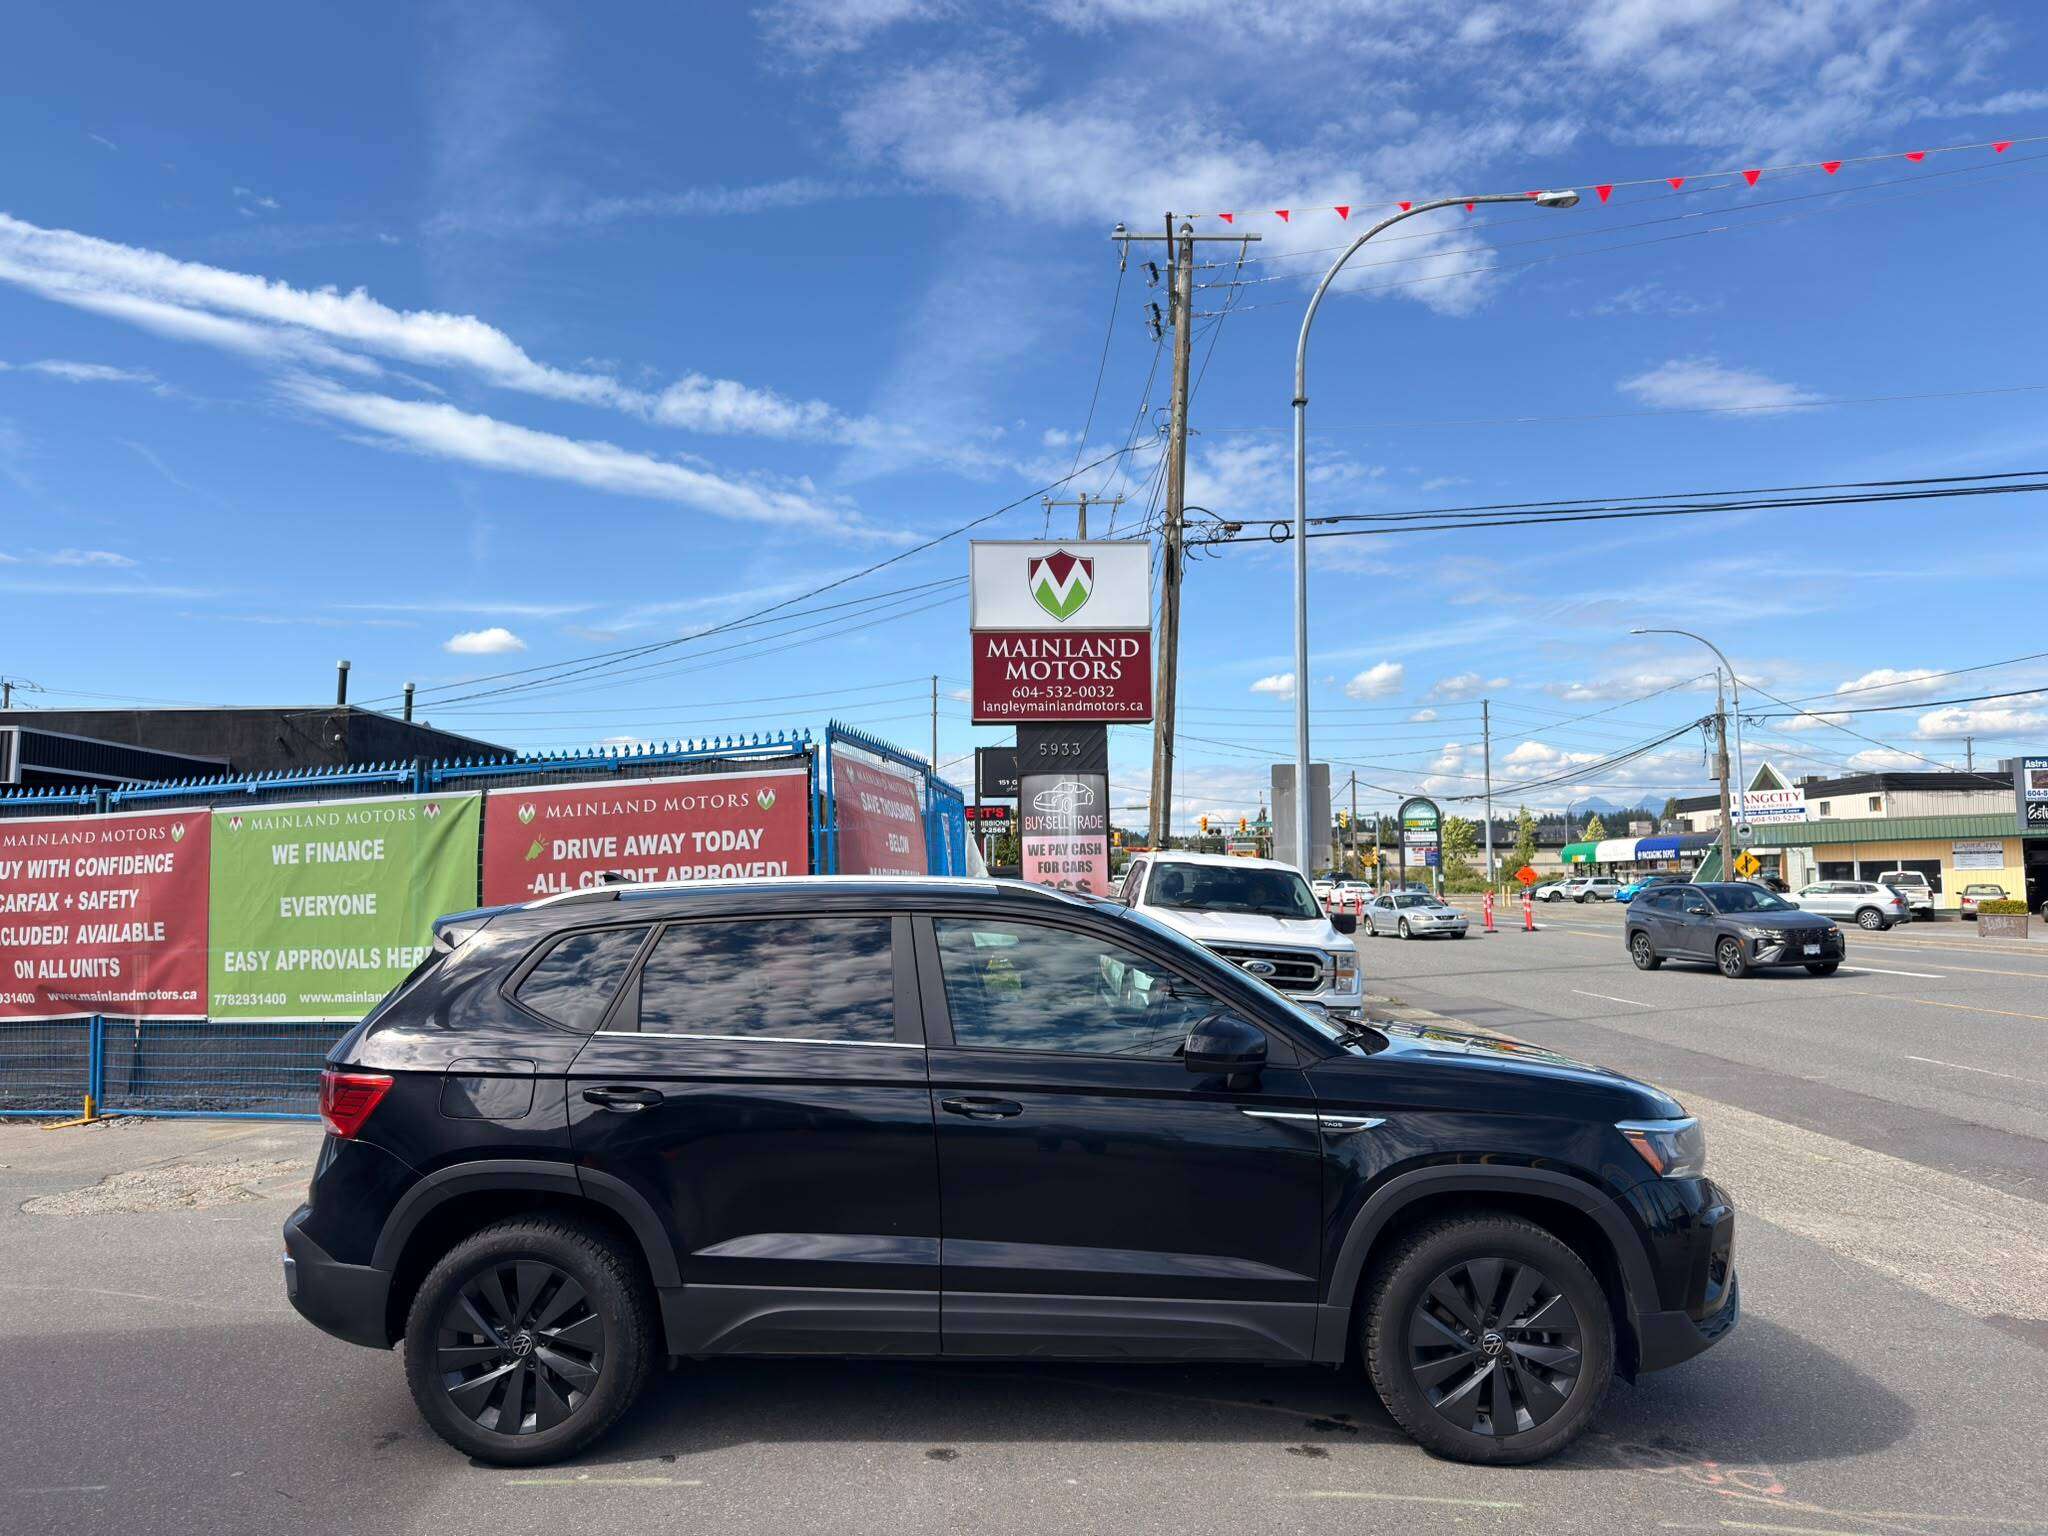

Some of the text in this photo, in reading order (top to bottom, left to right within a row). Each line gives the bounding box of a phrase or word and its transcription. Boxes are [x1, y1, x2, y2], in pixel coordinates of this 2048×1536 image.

[986, 638, 1139, 658] MAINLAND
[1005, 660, 1122, 681] MOTORS
[1012, 685, 1115, 698] 604-532-0032
[983, 700, 1144, 714] langleymainlandmotors.ca
[1039, 742, 1081, 756] 5933
[546, 793, 749, 819] MAINLAND MOTORS
[251, 808, 416, 831] MAINLAND MOTORS
[3, 827, 166, 847] MAINLAND MOTORS
[553, 828, 765, 860] DRIVE AWAY TODAY
[272, 839, 385, 865] WE FINANCE
[1027, 842, 1102, 856] WE PAY CASH
[28, 858, 70, 879] WITH
[75, 853, 174, 877] CONFIDENCE
[1037, 860, 1093, 873] FOR CARS
[78, 889, 140, 910] SAFETY
[280, 894, 376, 918] EVERYONE
[0, 922, 165, 946] CLUDED! AVAILABLE
[14, 957, 120, 978] ON ALL UNITS
[224, 951, 270, 972] EASY
[276, 948, 381, 971] APPROVALS
[47, 989, 197, 1002] www.mainlandmotors.ca
[214, 993, 287, 1005] 7782931400
